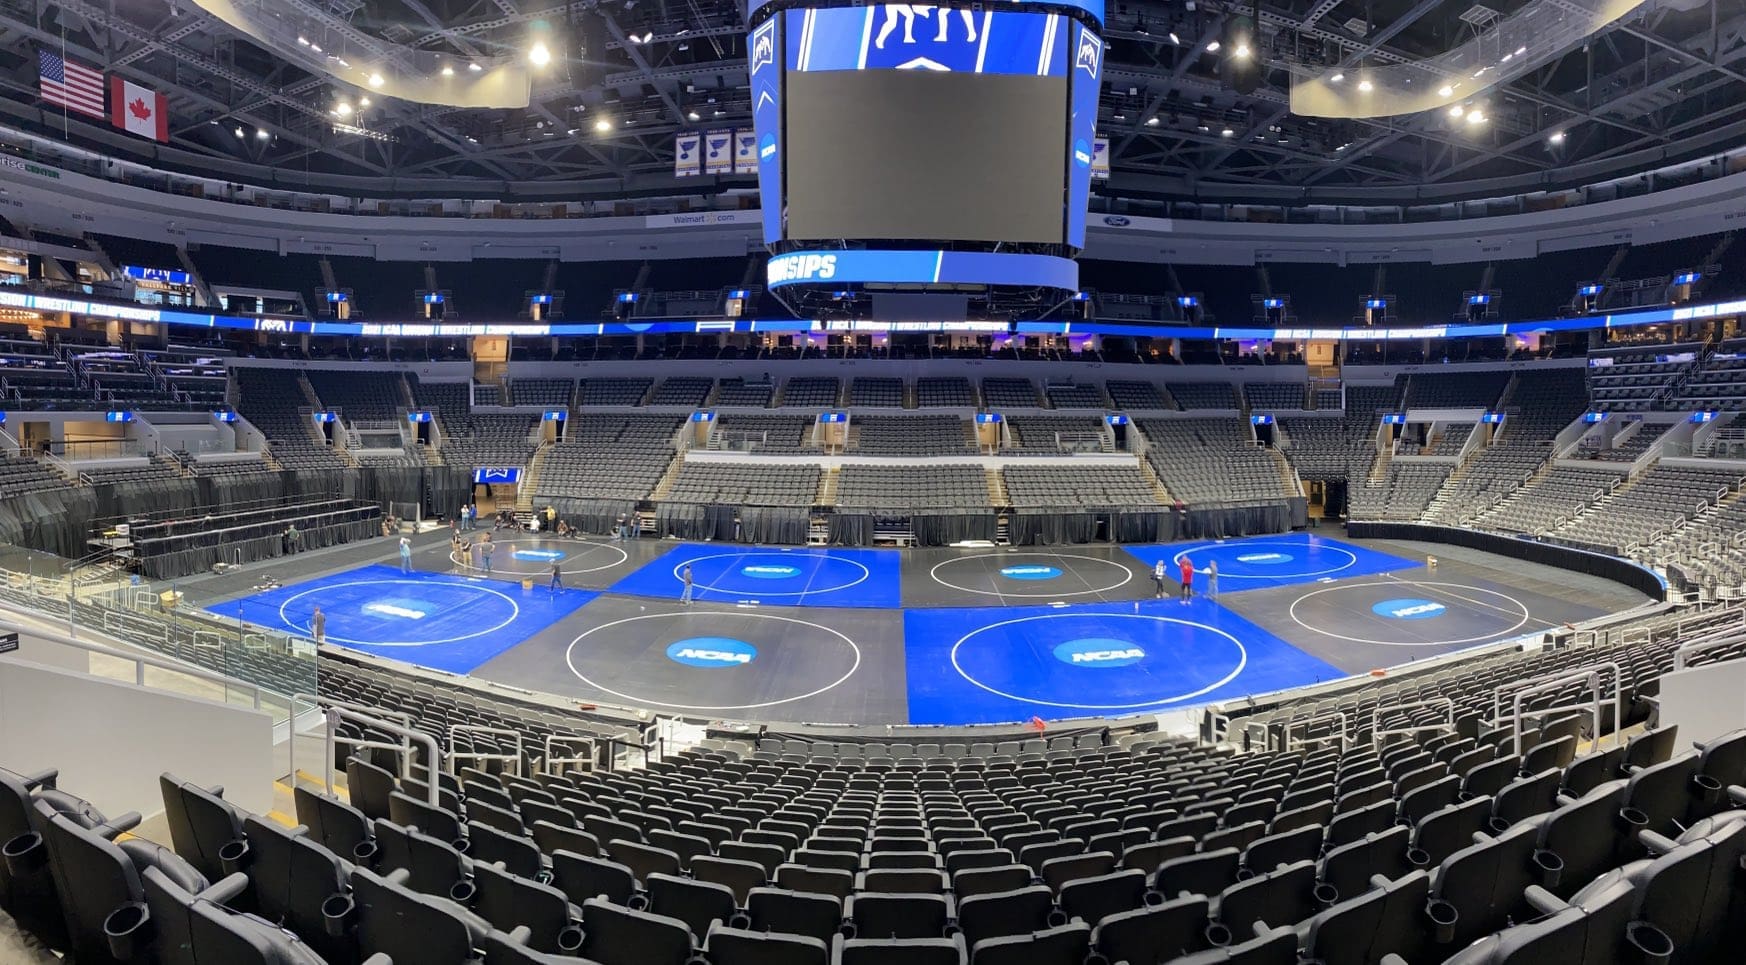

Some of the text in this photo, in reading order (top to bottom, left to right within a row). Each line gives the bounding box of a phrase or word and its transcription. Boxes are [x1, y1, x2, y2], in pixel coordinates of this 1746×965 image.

[673, 215, 705, 224] Walmart
[1391, 603, 1446, 617] NCAA
[676, 648, 752, 663] NCAA
[1072, 649, 1145, 662] NCAA
